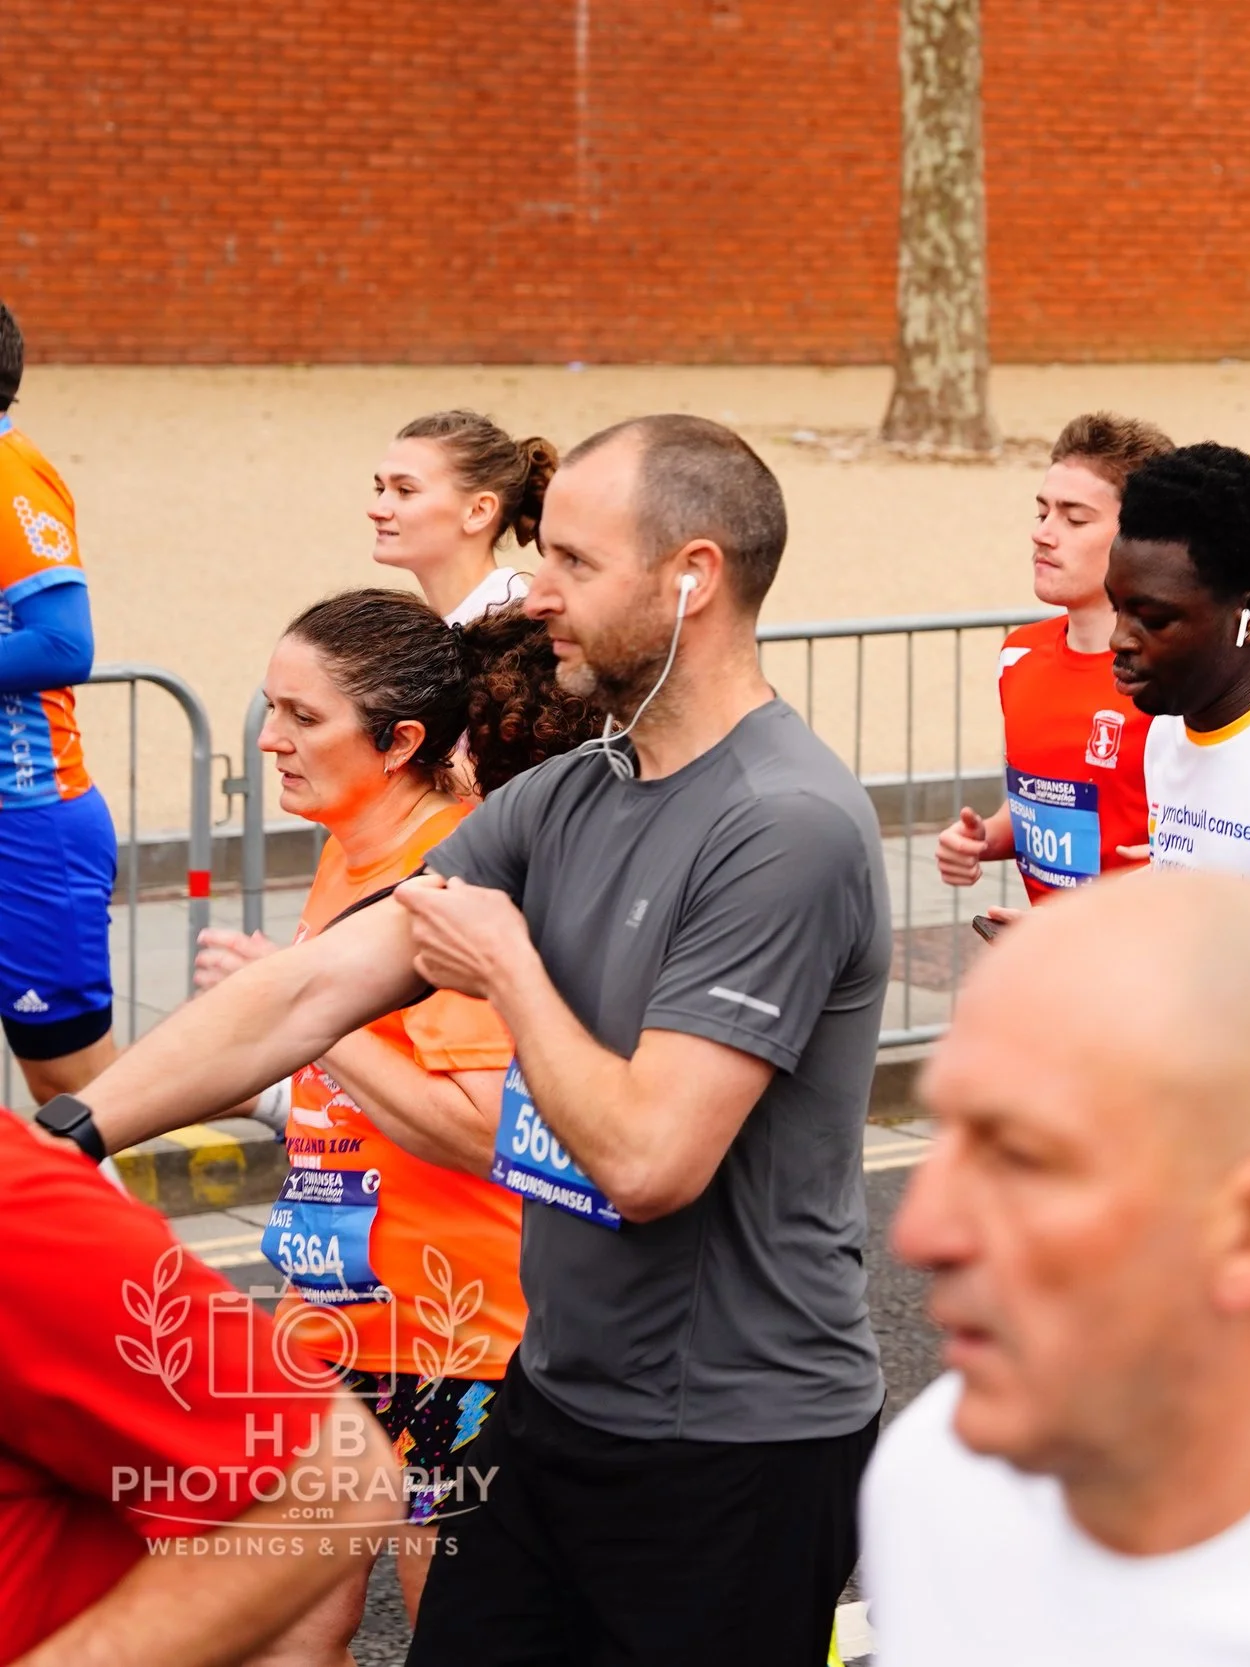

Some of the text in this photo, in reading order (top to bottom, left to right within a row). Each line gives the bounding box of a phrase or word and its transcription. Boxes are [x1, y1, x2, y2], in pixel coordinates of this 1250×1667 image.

[11, 739, 35, 791] CURE
[1036, 778, 1077, 795] SWANSEA
[1160, 804, 1208, 831] ymchwil
[1021, 821, 1073, 867] 7801
[1157, 831, 1195, 854] cymru
[303, 1171, 344, 1187] SWANSEA
[269, 1208, 293, 1229] KATE
[278, 1231, 345, 1277] 5364
